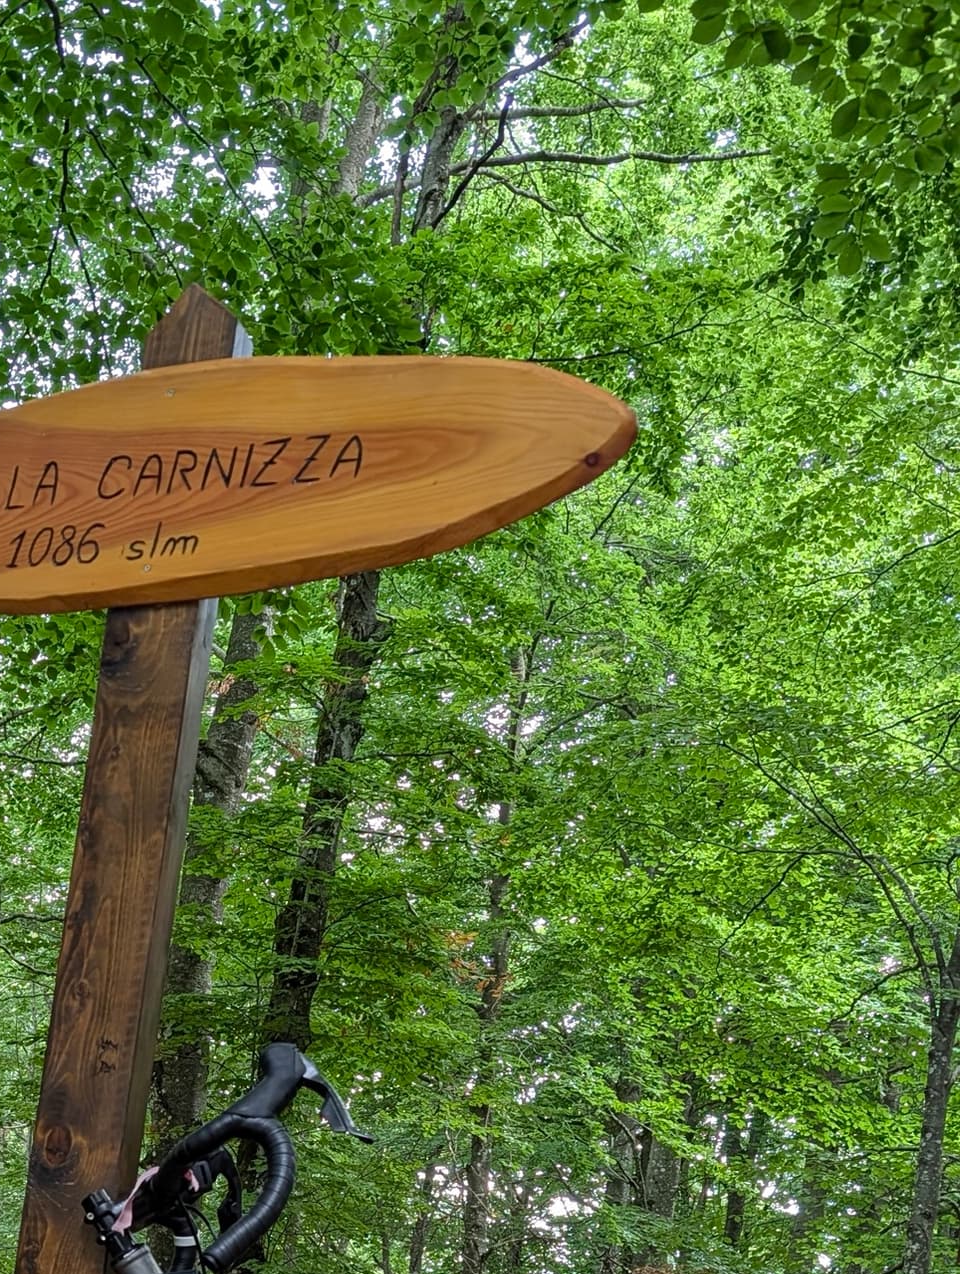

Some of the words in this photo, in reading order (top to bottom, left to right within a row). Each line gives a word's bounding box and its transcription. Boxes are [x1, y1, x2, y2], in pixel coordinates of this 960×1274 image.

[97, 433, 364, 501] CARNIZZA
[5, 522, 106, 569] 1086
[125, 519, 200, 561] slm
